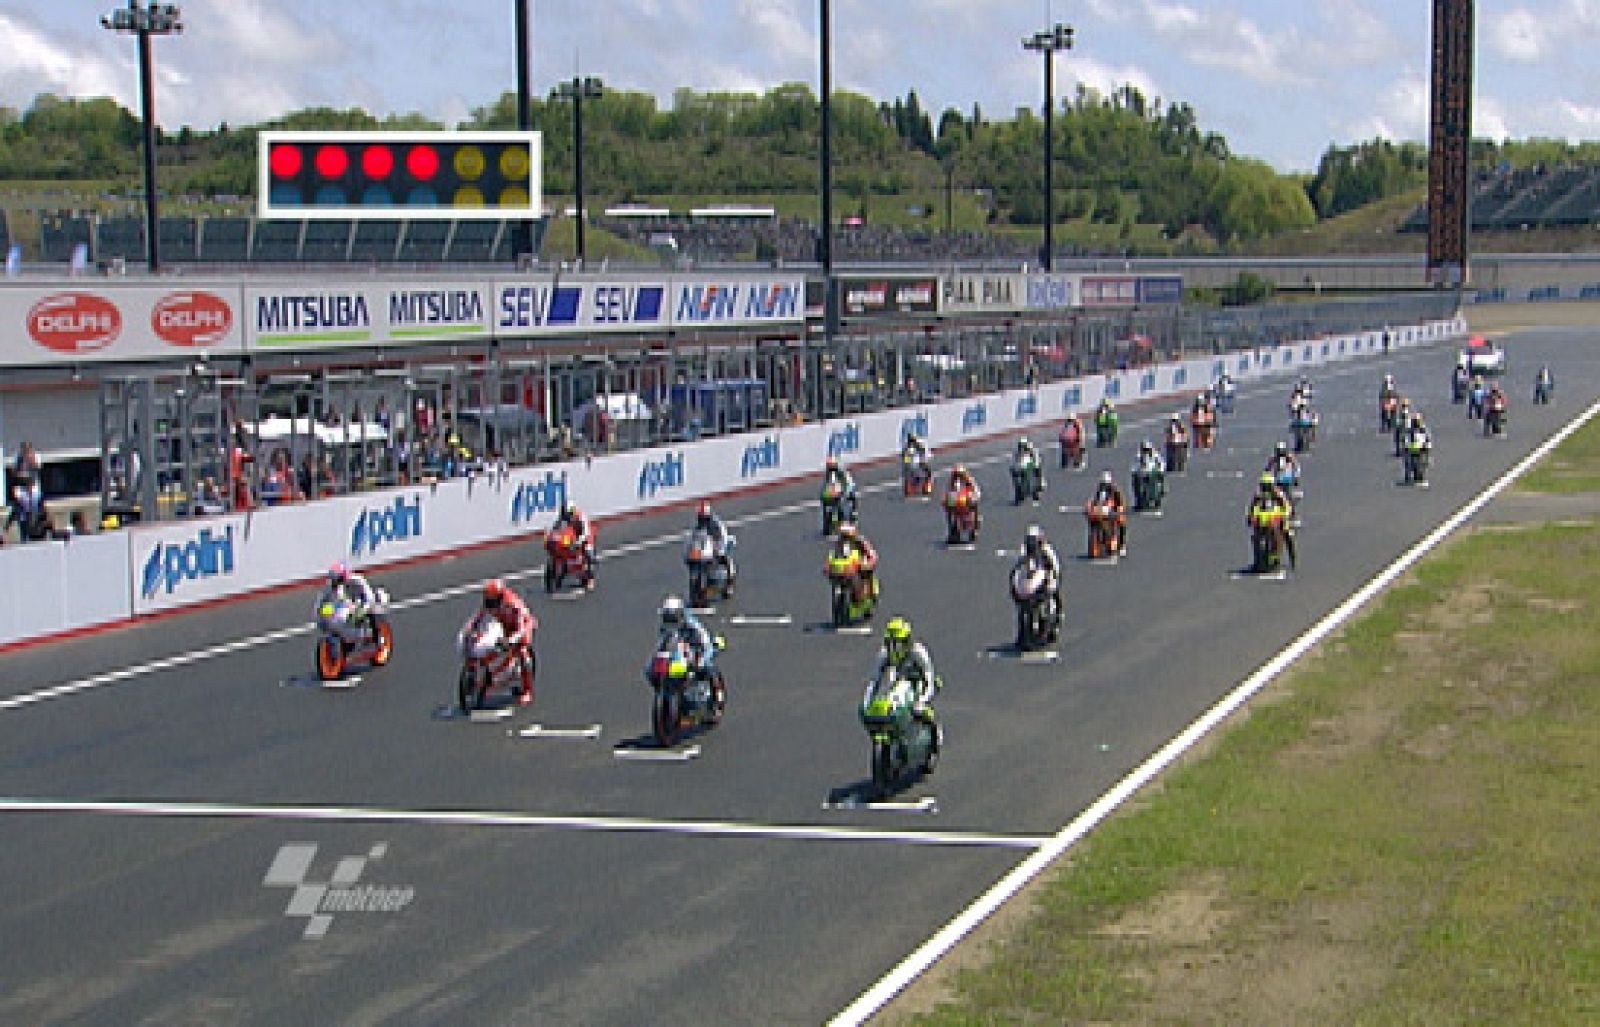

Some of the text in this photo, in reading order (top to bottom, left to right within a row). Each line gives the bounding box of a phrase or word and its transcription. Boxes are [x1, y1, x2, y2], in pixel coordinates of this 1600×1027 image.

[258, 290, 484, 331] MITSUBA MITSUBA
[501, 287, 553, 326] SEV
[369, 492, 422, 552] polini
[164, 524, 234, 594] polini
